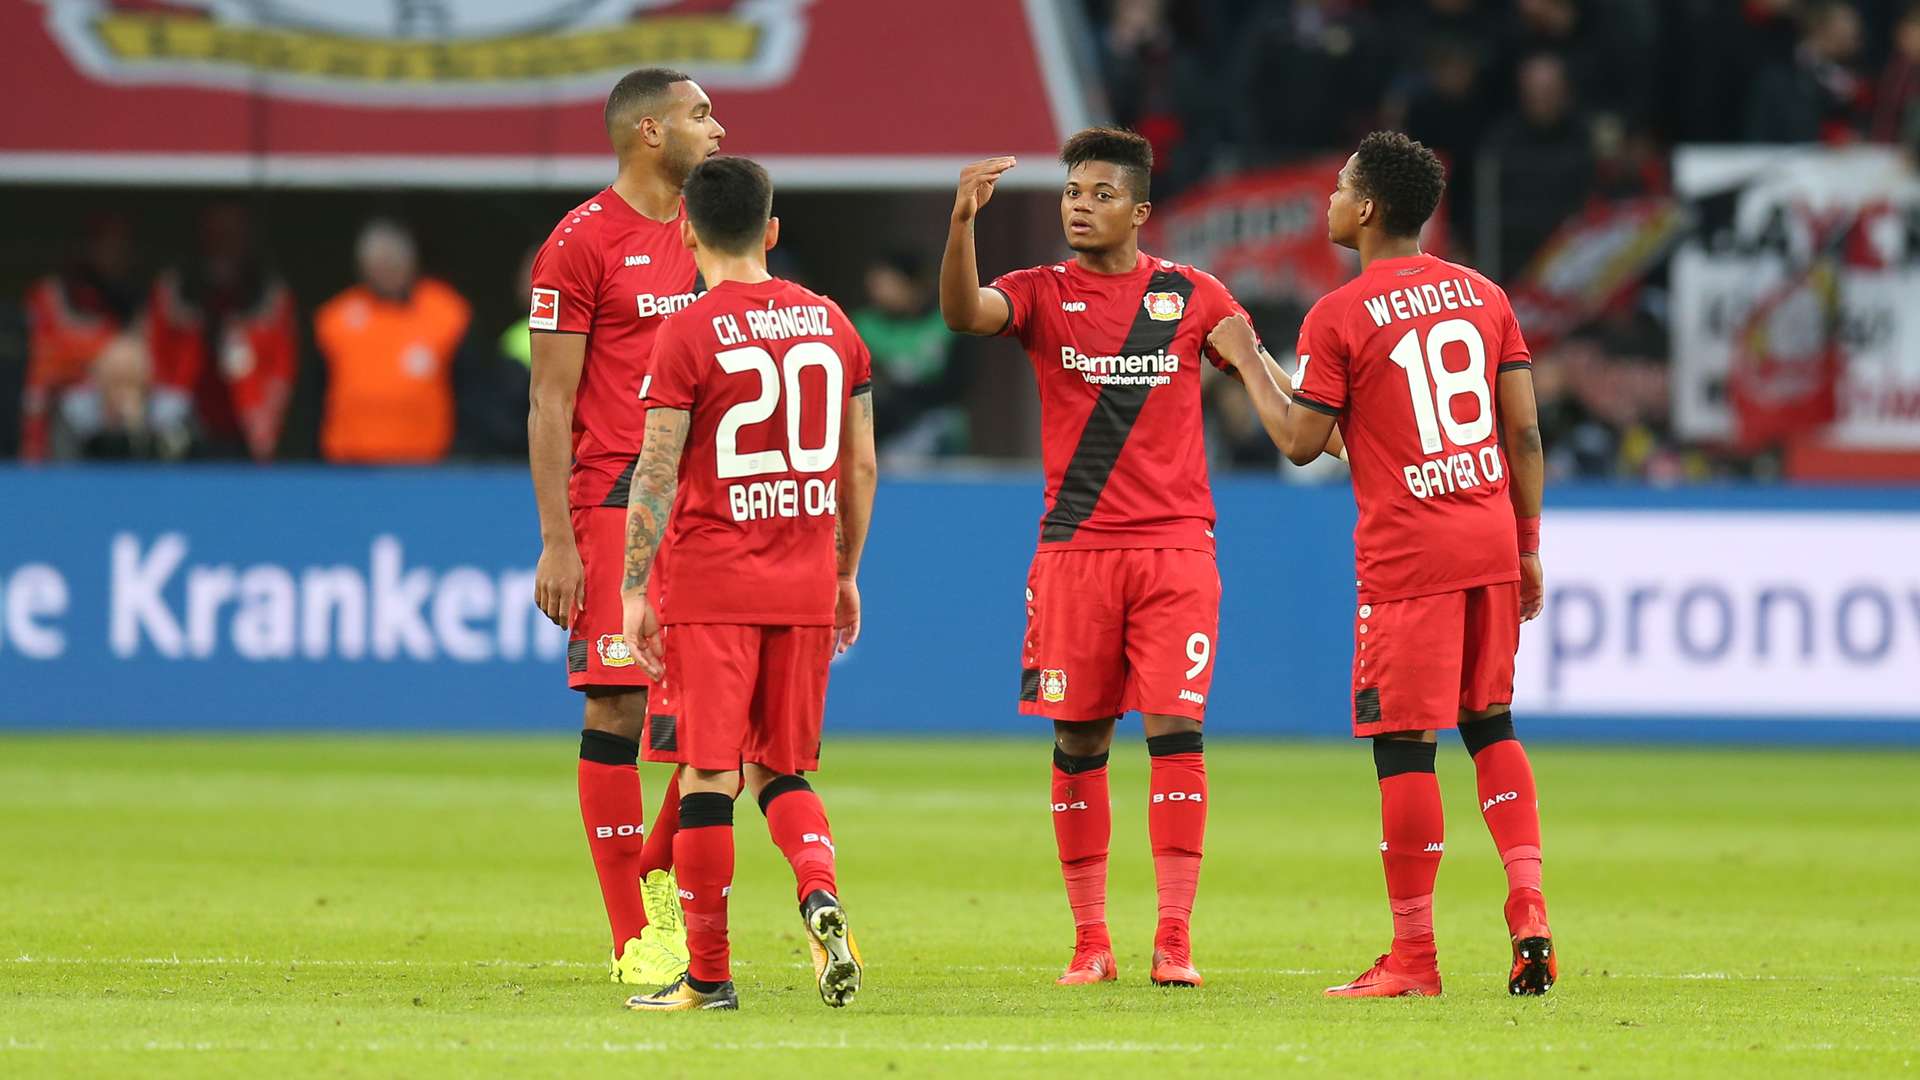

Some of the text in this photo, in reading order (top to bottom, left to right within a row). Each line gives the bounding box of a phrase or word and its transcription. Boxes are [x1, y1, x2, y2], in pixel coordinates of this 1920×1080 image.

[624, 254, 651, 267] JAKO
[1364, 278, 1484, 327] WENDELL
[712, 314, 748, 345] CH.
[1061, 346, 1179, 373] Barmenia
[1082, 371, 1171, 388] Versicherungen
[1388, 318, 1493, 455] 18
[715, 342, 844, 479] 20
[1403, 451, 1481, 499] BAYER
[110, 531, 567, 660] Kranken
[1185, 632, 1210, 680] 9
[1178, 688, 1204, 704] JAKO
[1483, 791, 1518, 812] JAKO
